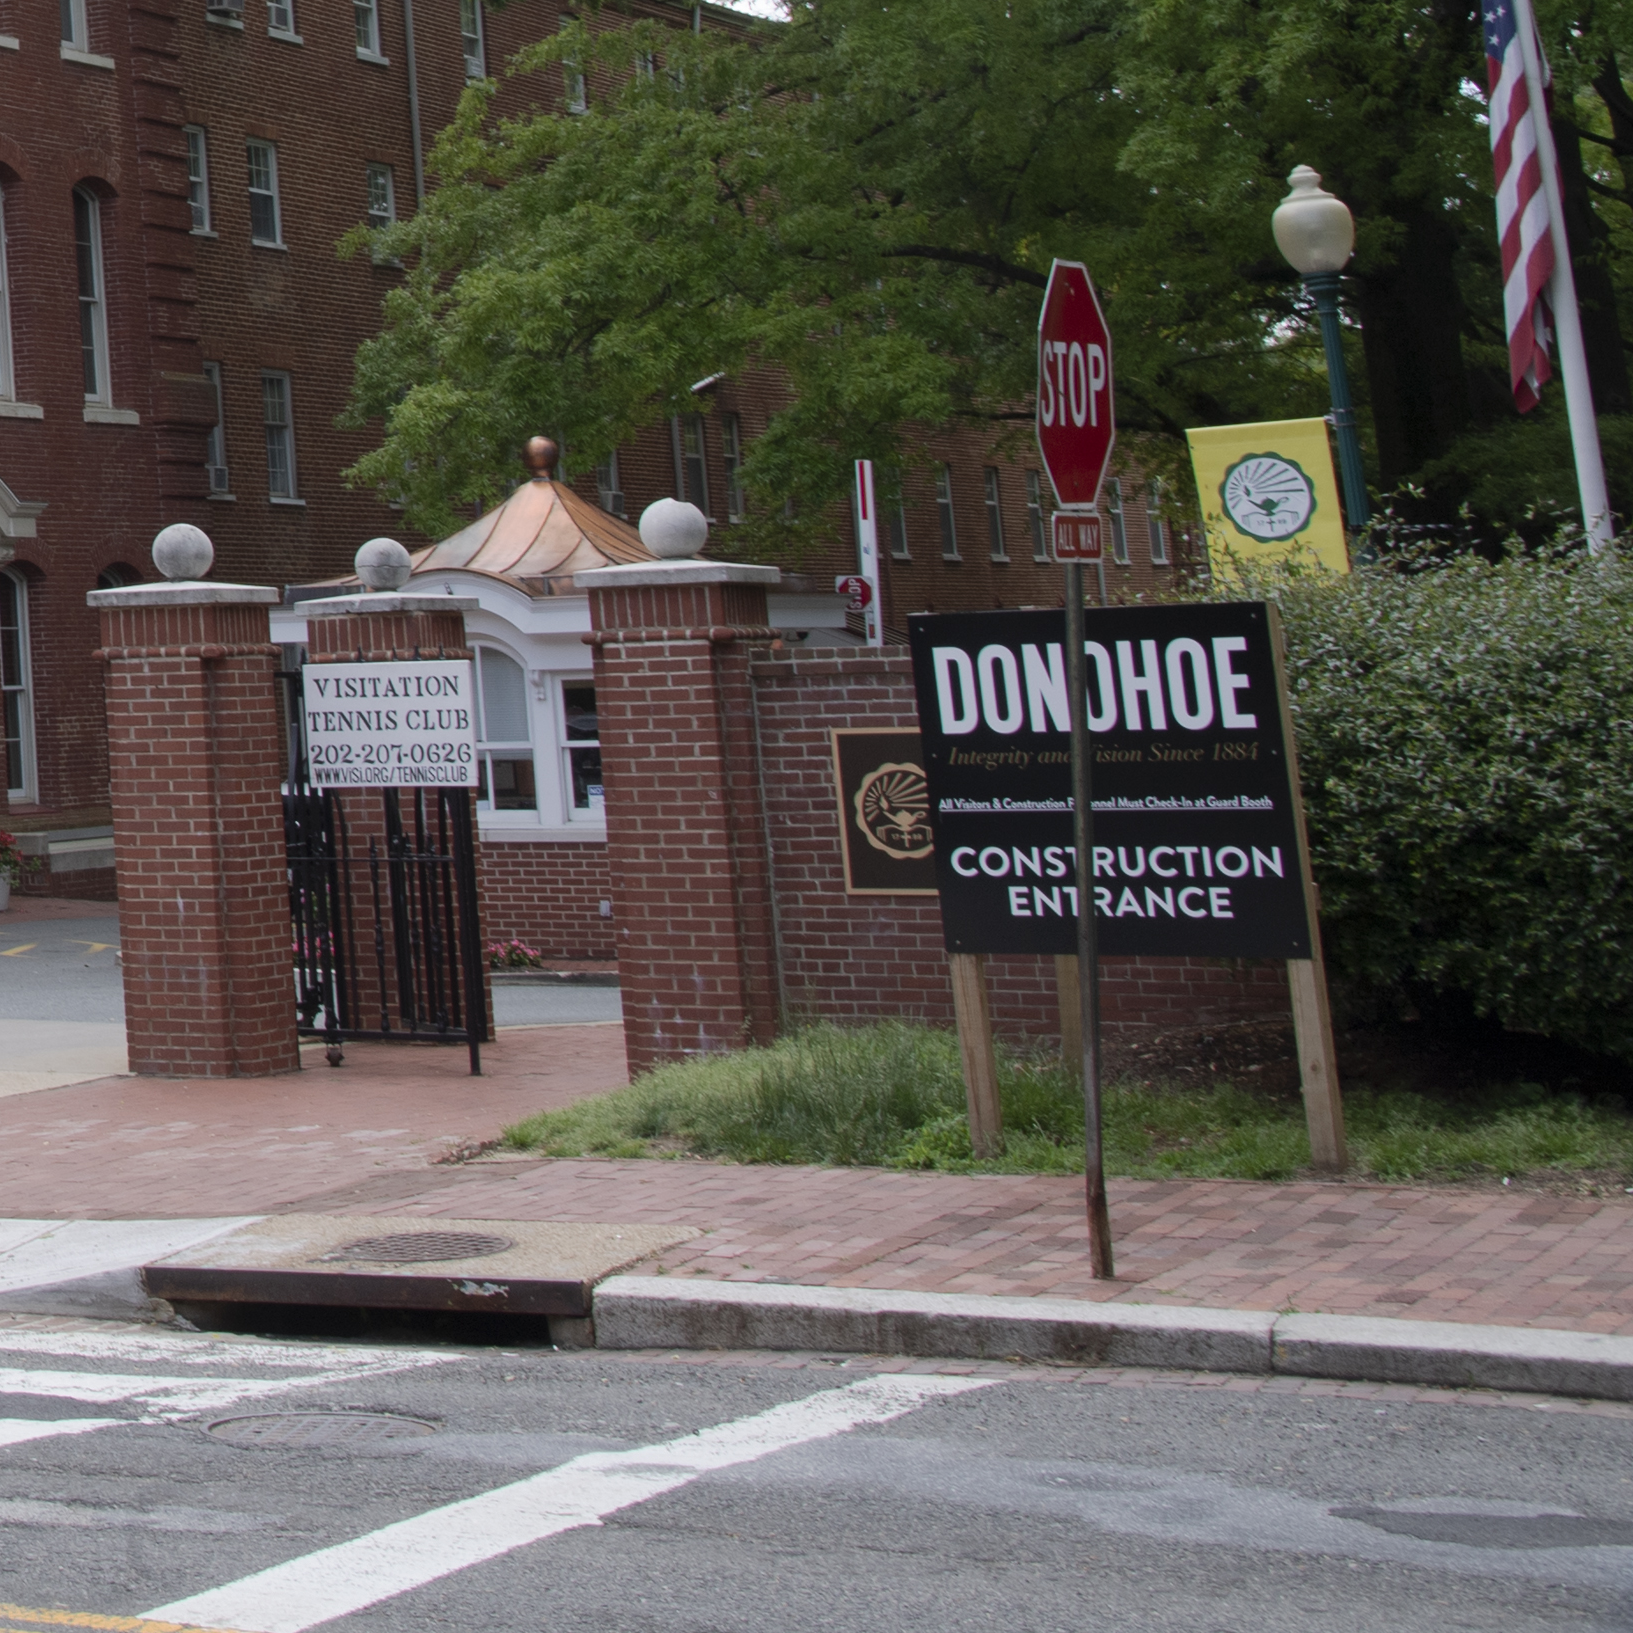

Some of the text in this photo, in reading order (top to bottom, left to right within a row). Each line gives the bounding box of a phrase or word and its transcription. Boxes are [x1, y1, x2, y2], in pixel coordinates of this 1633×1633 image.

[1041, 340, 1106, 427] STOP
[1058, 523, 1098, 551] ALL WAY
[312, 675, 460, 698] VISITATION
[932, 636, 1258, 735] DONOHOE
[308, 709, 469, 732] TENNIS CLUB
[310, 743, 472, 764] 202-207-0626
[949, 745, 1034, 770] Integrity
[1092, 744, 1142, 763] ision
[1148, 742, 1205, 763] Since
[1213, 742, 1260, 761] 1884
[939, 795, 1273, 809] All Visitors & Construction Pnnel Must Check-In at Guard Booth
[1007, 885, 1235, 919] ENTRANCE
